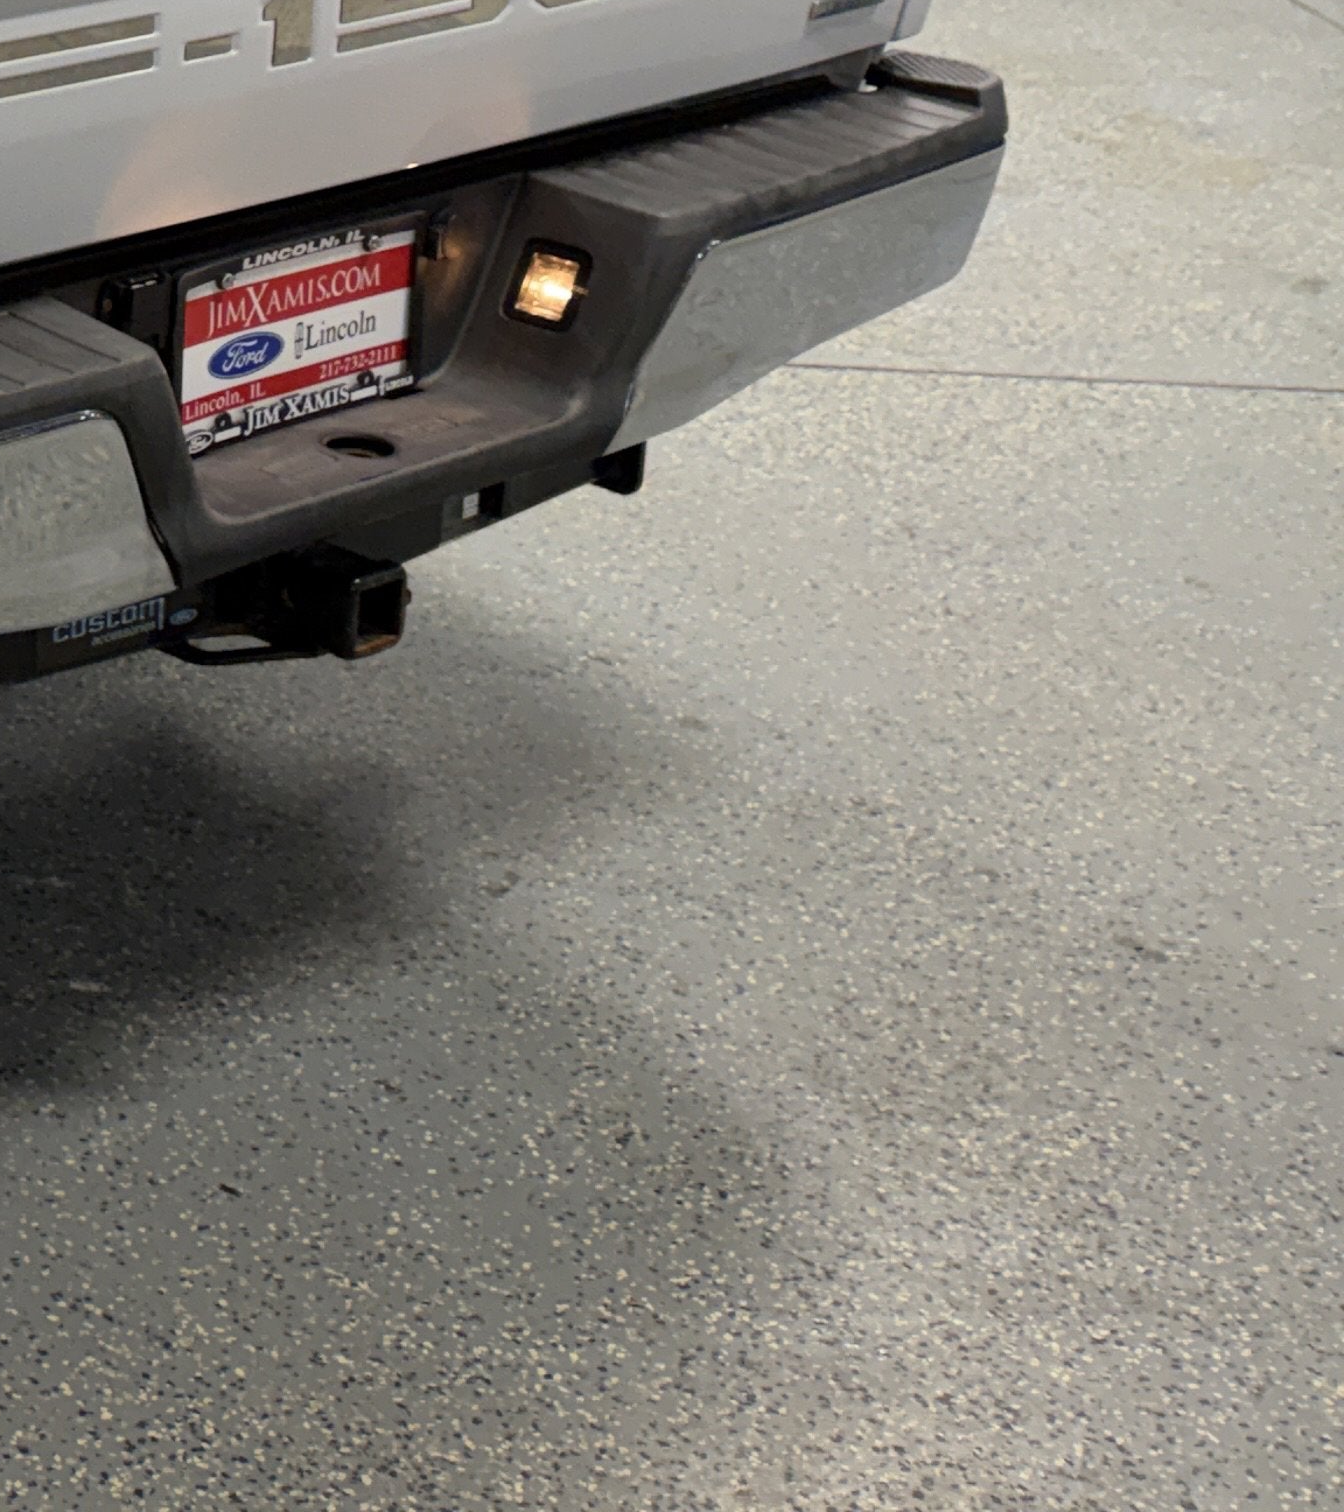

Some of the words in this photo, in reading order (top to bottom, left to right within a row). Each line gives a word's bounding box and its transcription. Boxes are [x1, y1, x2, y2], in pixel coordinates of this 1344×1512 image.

[345, 229, 365, 244] IL
[304, 310, 377, 351] Lincoln
[221, 340, 268, 373] Ford
[318, 345, 398, 380] 217-732-2111
[249, 383, 266, 399] IL
